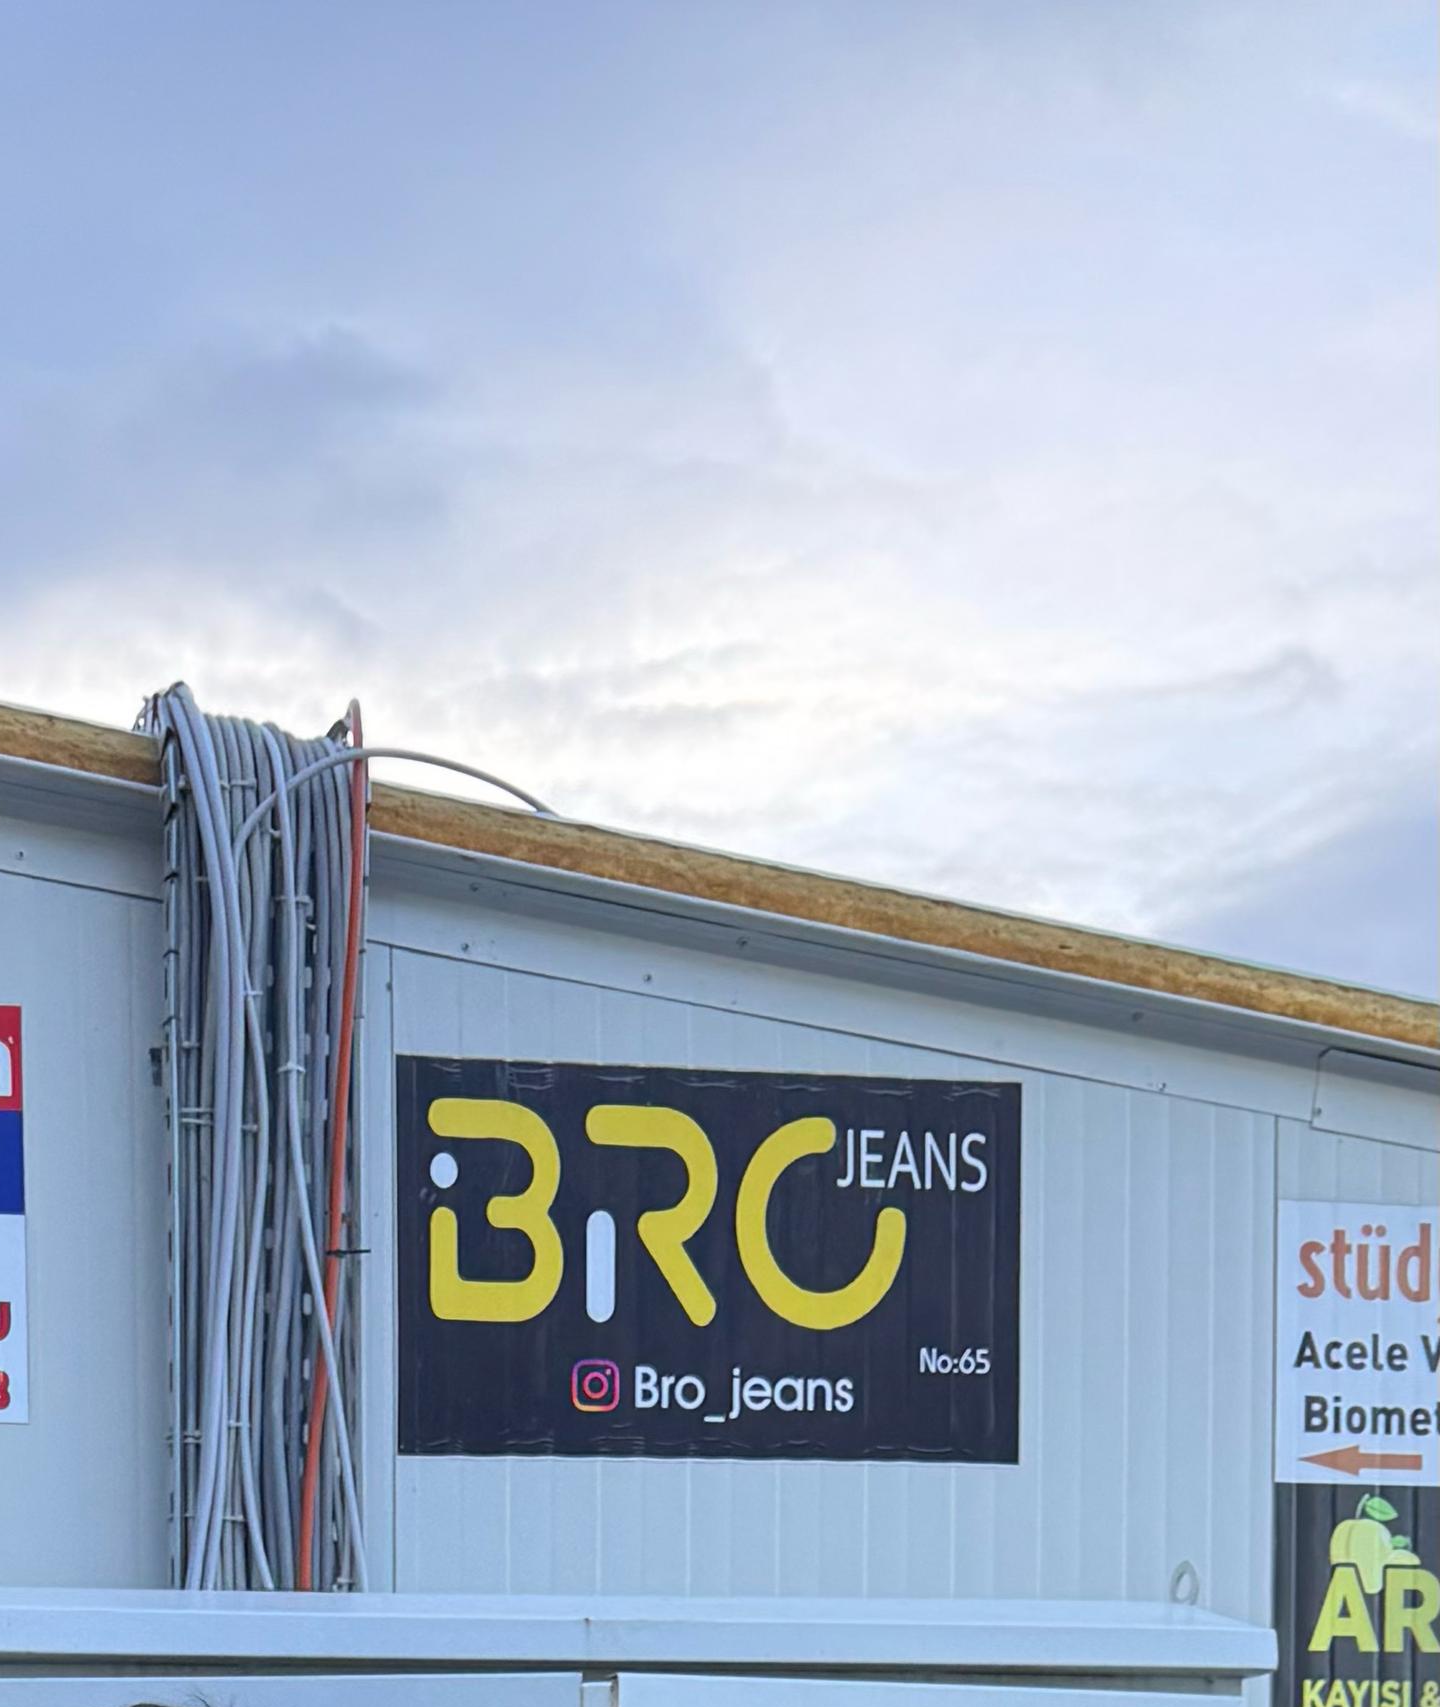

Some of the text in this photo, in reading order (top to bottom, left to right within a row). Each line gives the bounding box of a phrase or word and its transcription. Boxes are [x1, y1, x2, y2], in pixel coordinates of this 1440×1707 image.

[836, 1128, 988, 1194] JEANS
[1297, 1222, 1440, 1303] stüd
[919, 1346, 991, 1375] No:65
[1293, 1331, 1408, 1372] Acele
[634, 1365, 855, 1423] Bro_jeans
[1308, 1565, 1440, 1653] AR
